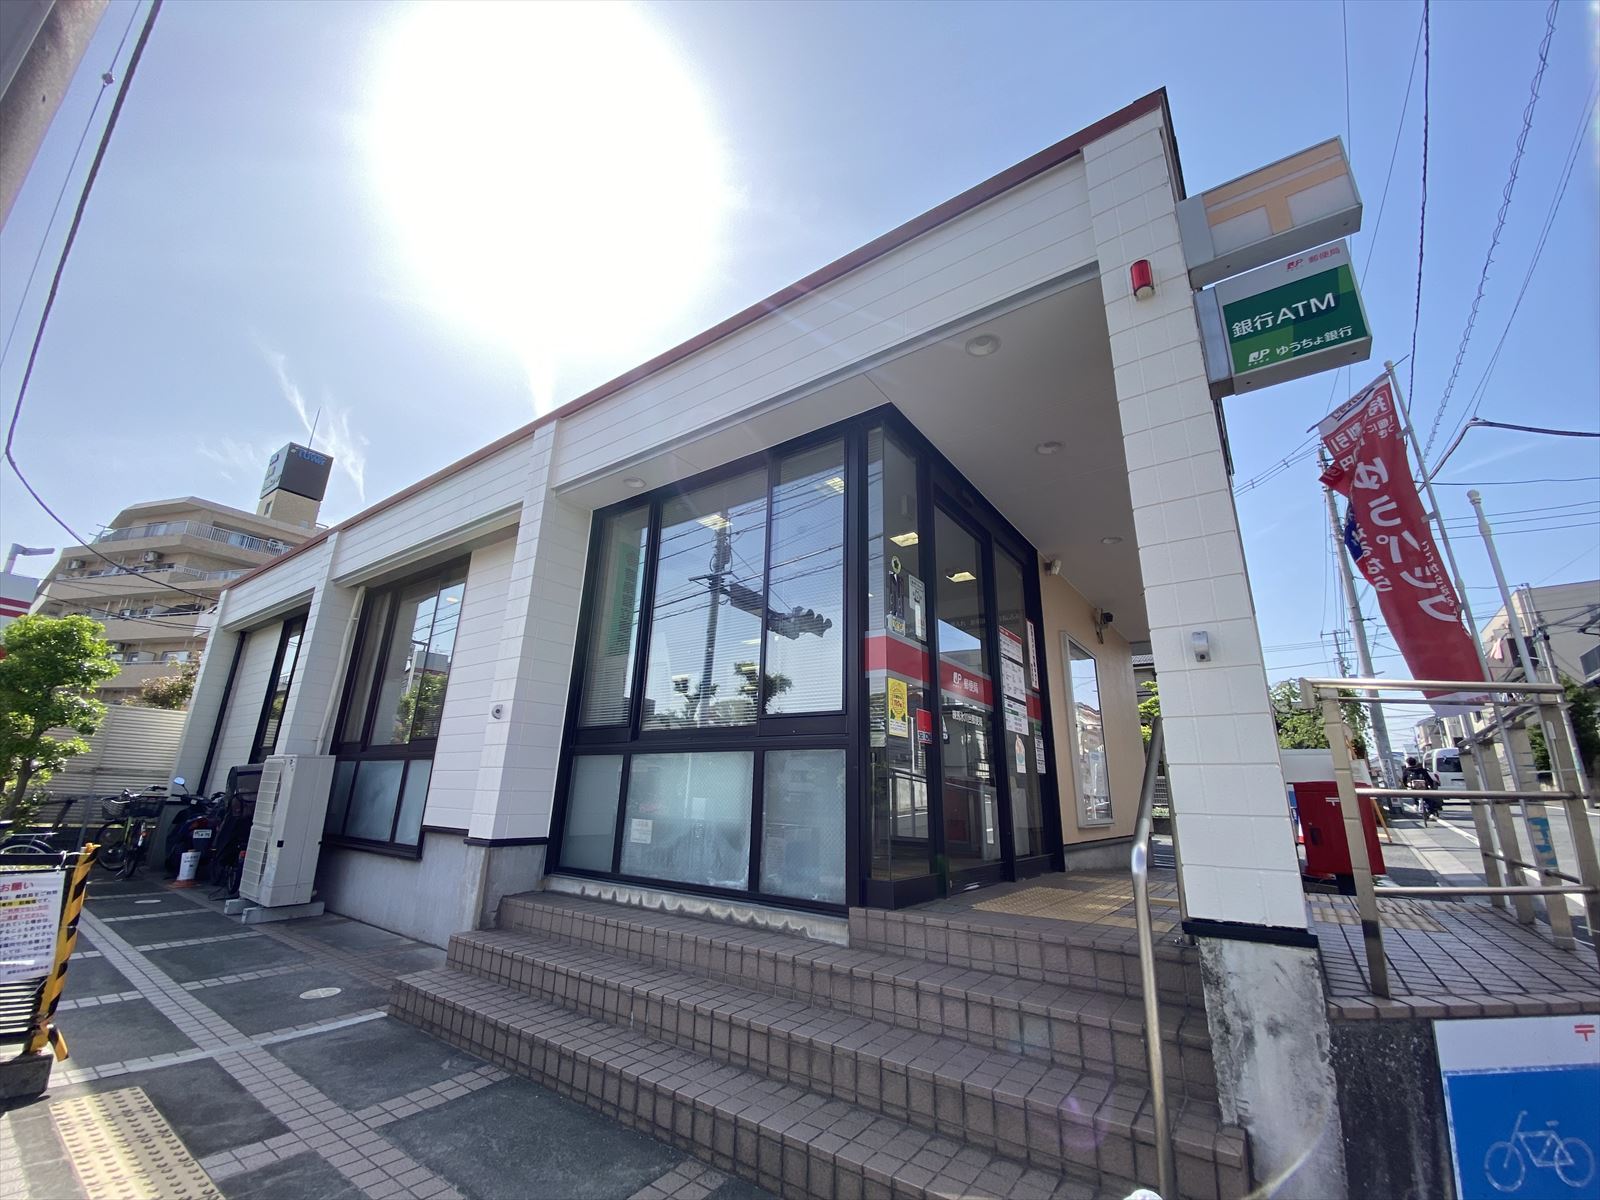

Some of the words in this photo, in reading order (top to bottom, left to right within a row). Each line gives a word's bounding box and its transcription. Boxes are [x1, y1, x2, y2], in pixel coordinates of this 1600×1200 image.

[1308, 246, 1341, 264] 郵便局
[1231, 292, 1336, 338] 銀行ATM
[1275, 325, 1353, 356] ゆうちょ銀行
